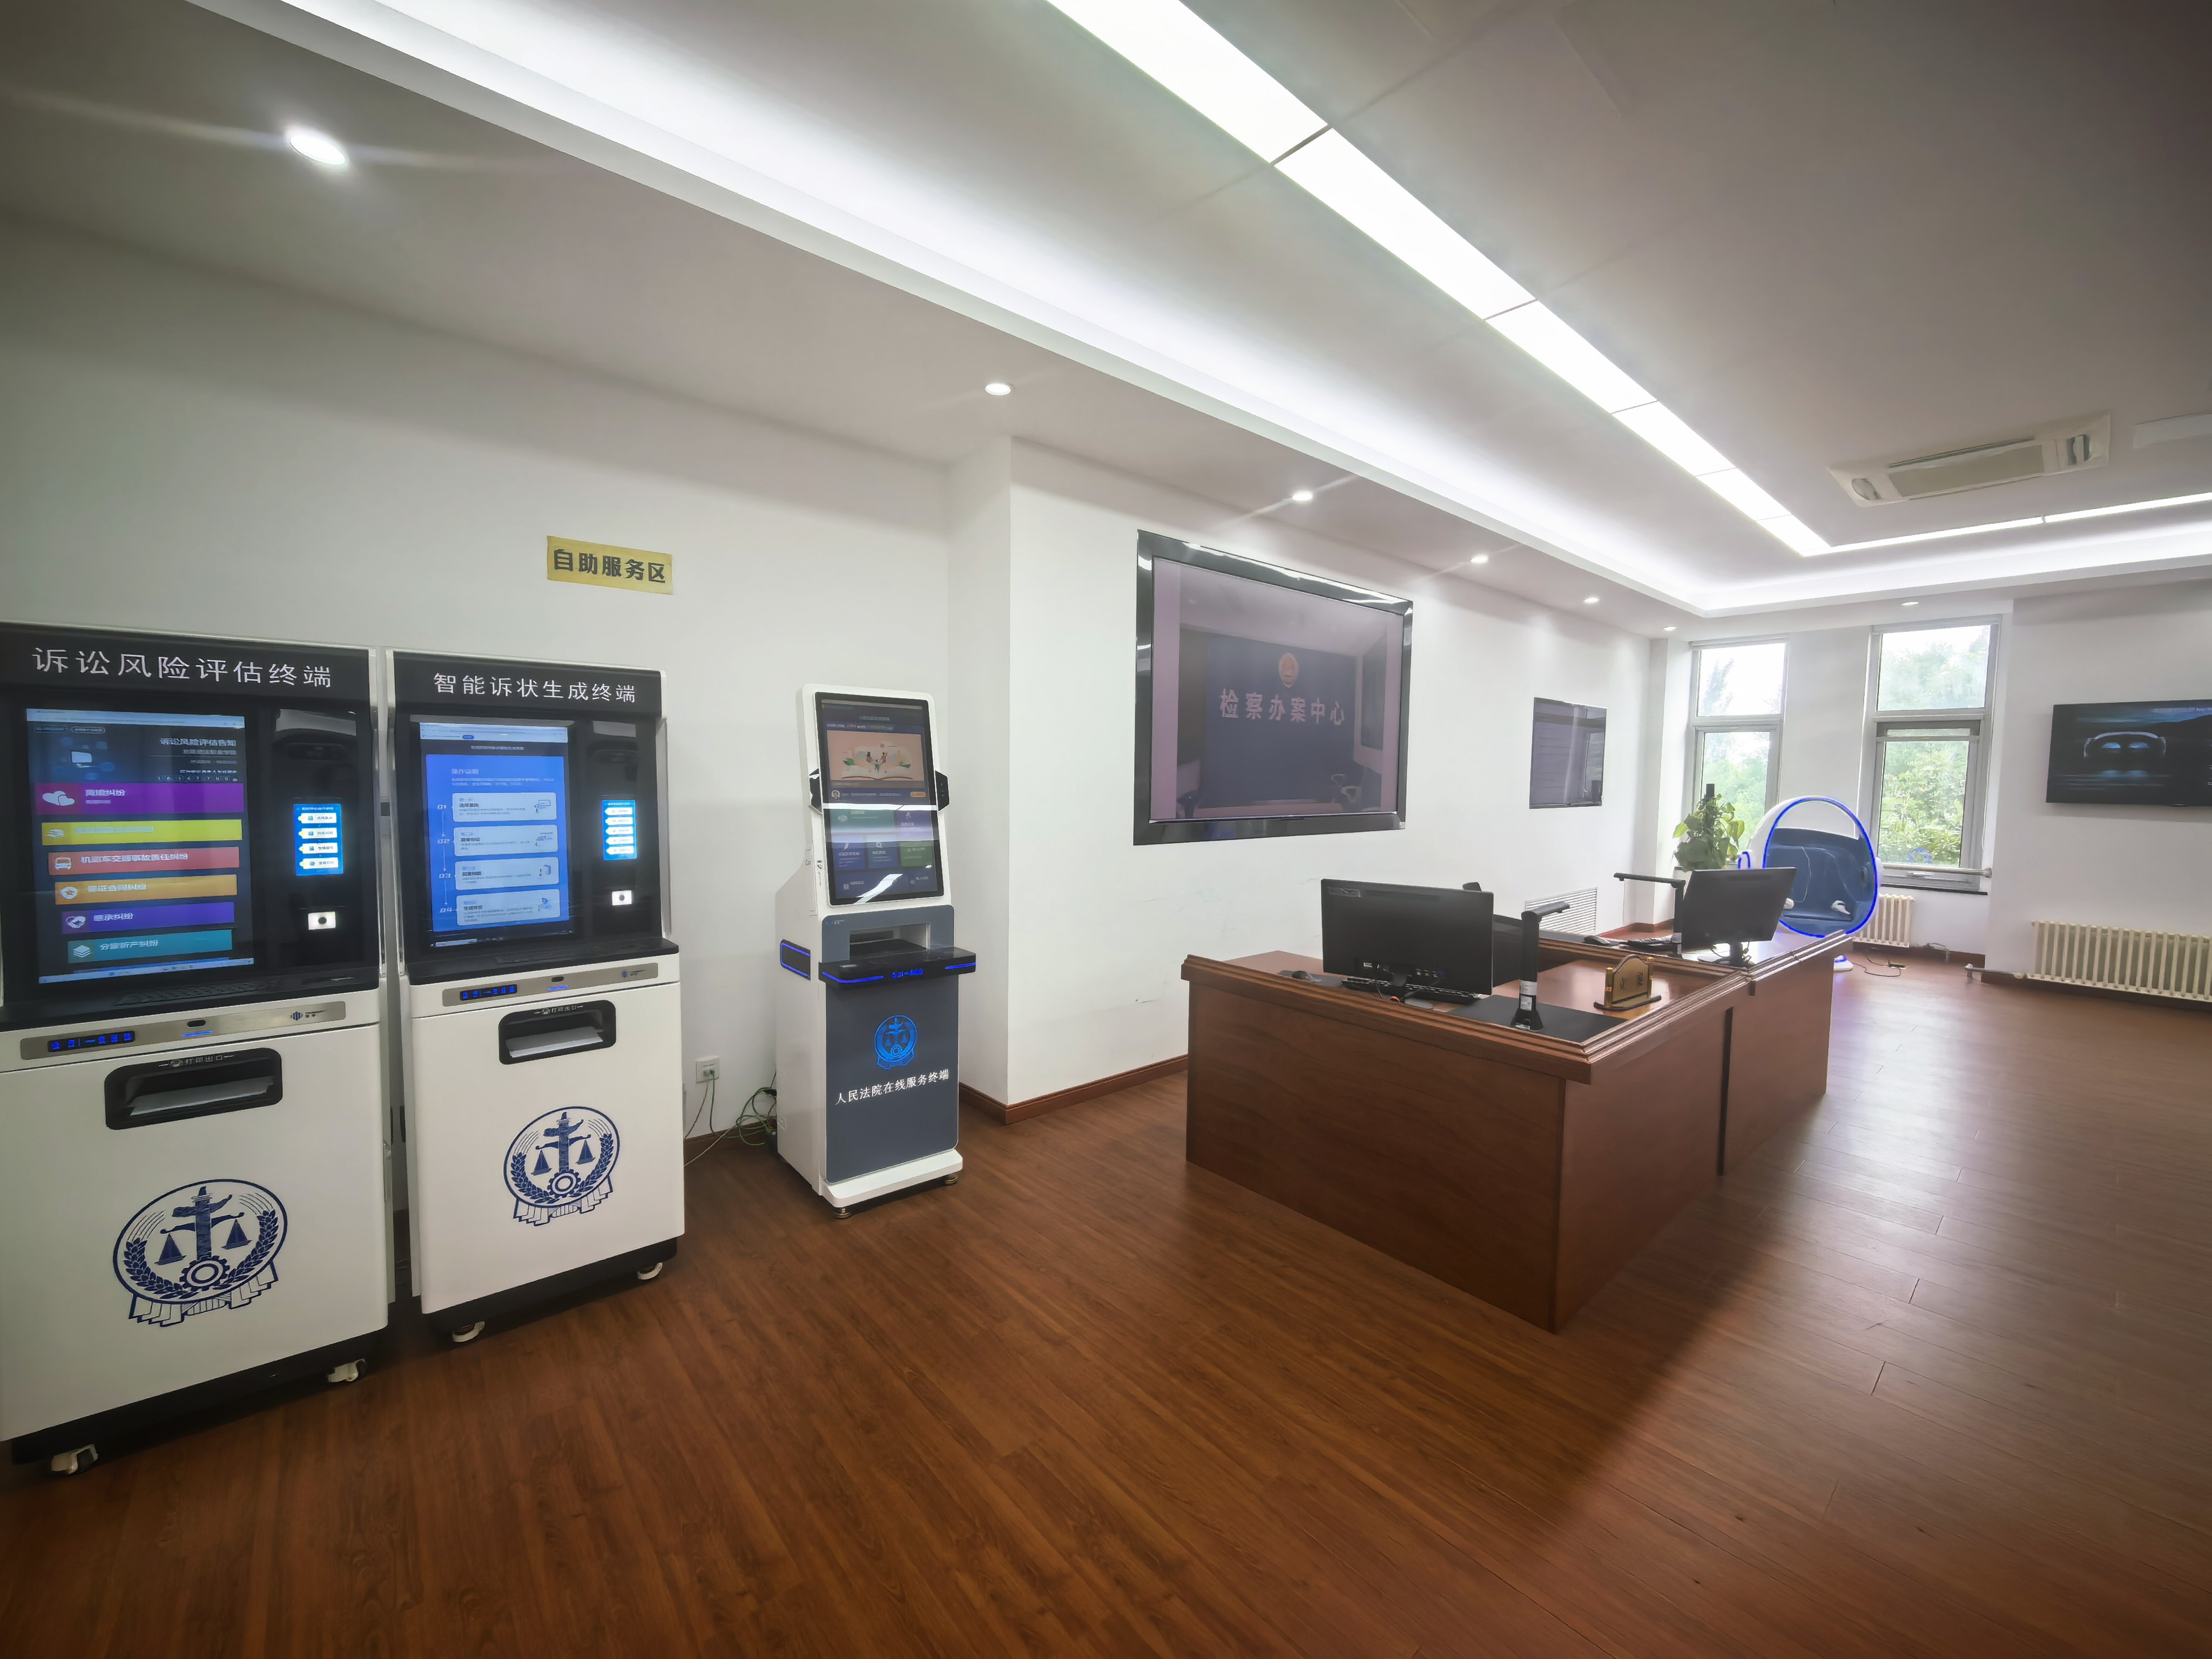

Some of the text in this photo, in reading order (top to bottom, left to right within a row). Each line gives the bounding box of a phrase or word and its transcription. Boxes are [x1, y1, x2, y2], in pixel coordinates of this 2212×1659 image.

[554, 548, 666, 583] 自助服务区
[32, 648, 331, 688] 诉讼风险评估终端
[433, 673, 635, 703] 智能诉状生成终端
[1219, 687, 1345, 725] 检察办案中心
[835, 1068, 950, 1105] 人民法院在线服务终端
